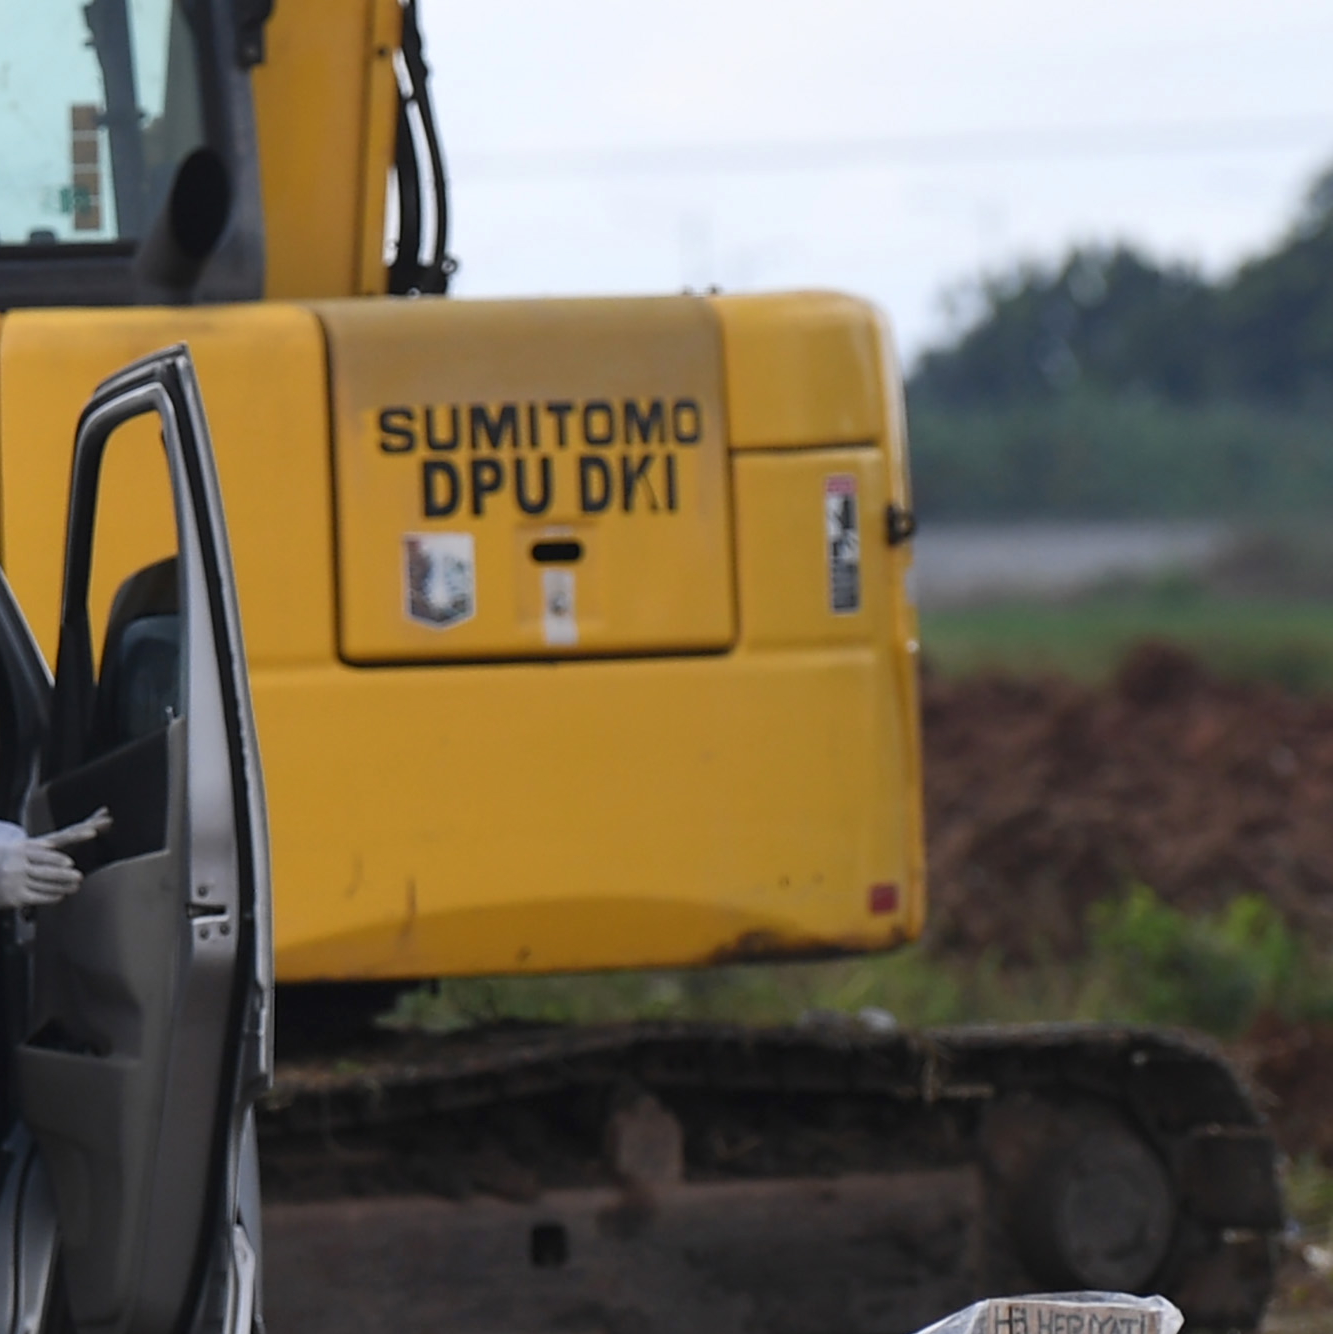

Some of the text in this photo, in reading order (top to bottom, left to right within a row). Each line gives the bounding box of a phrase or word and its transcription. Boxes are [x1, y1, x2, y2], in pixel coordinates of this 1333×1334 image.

[378, 398, 703, 454] SUMITOMO
[422, 453, 679, 518] DPU DKI
